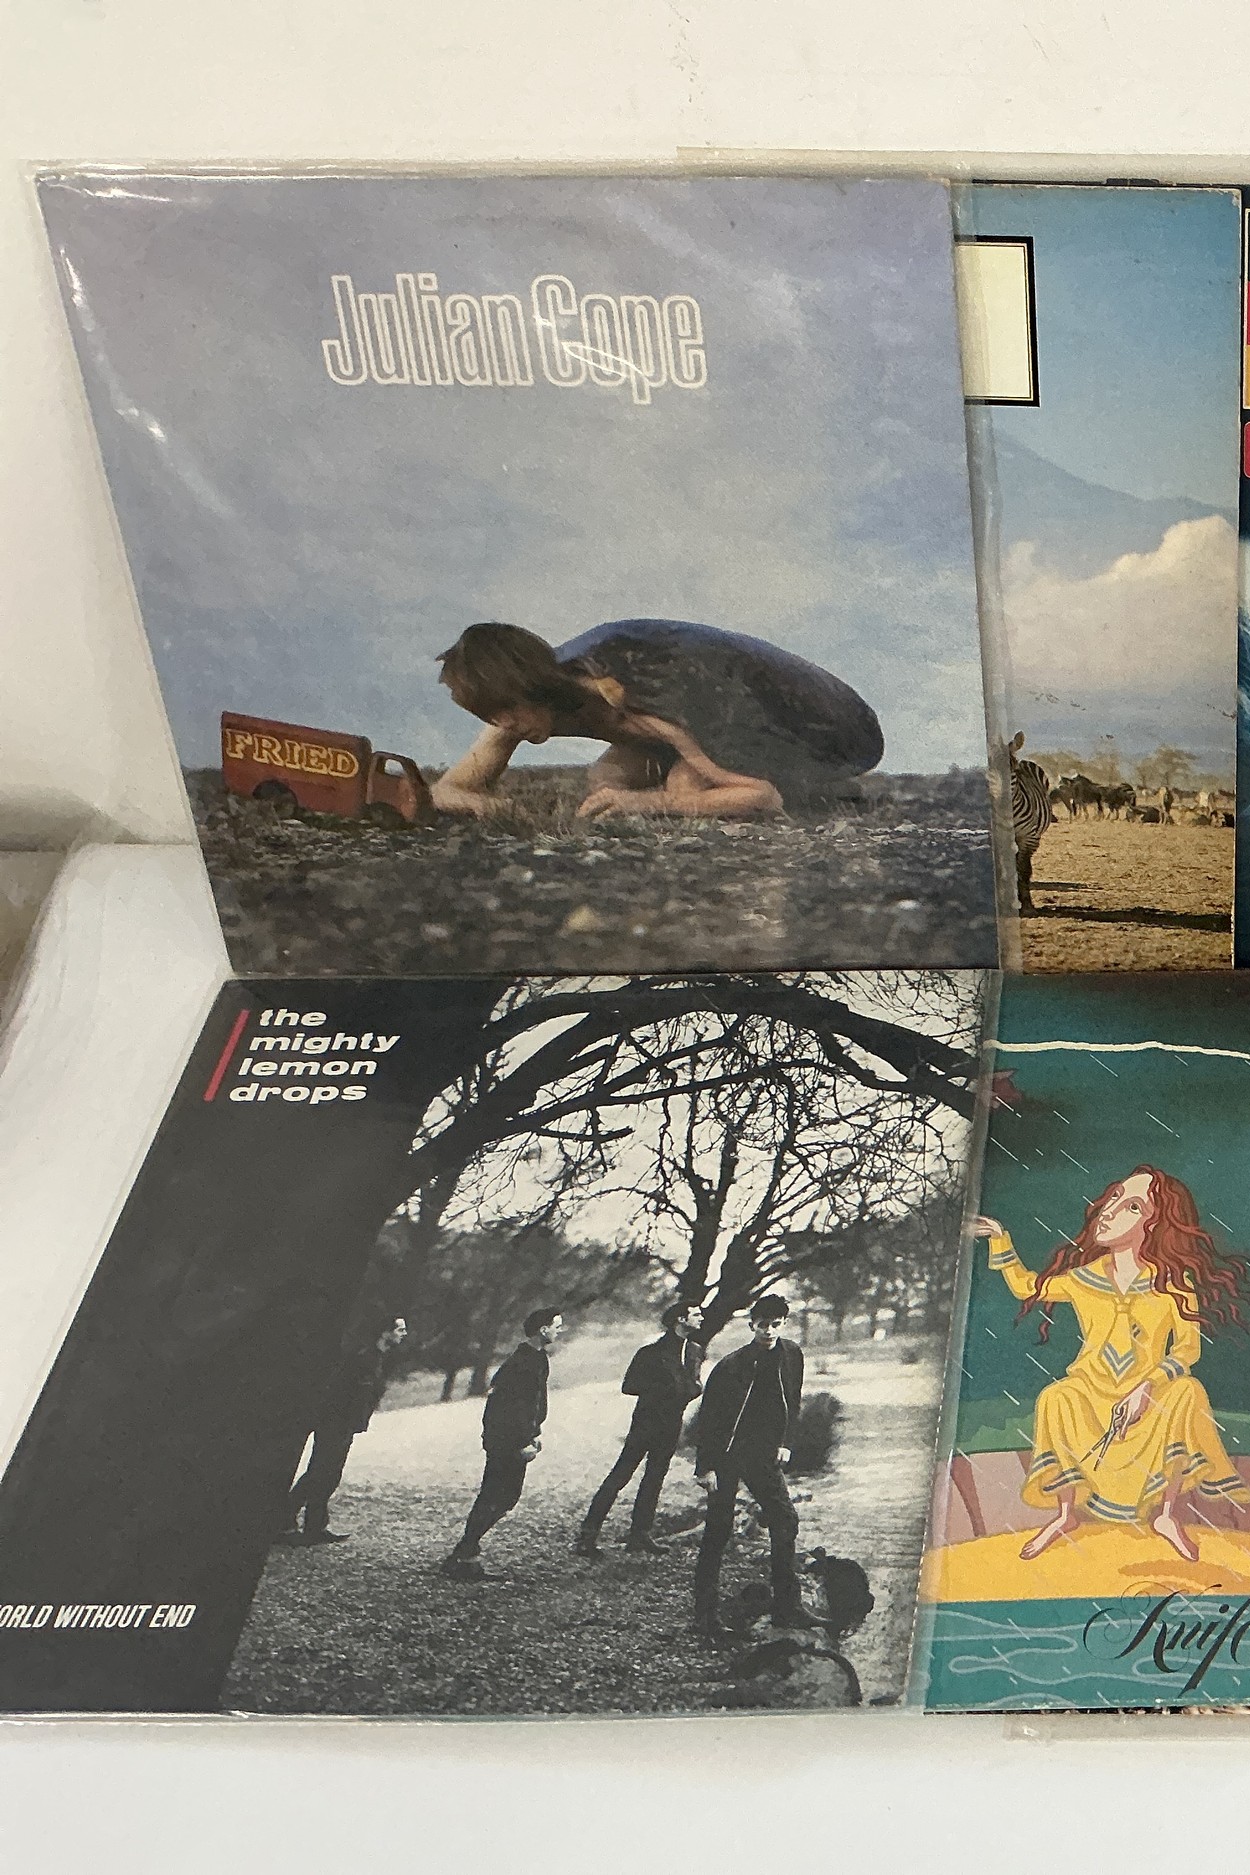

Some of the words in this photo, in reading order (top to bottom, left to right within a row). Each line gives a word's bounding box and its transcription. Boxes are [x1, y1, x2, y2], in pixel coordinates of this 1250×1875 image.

[321, 272, 534, 386] Julian
[531, 274, 707, 405] Cope
[225, 728, 359, 778] FRIED
[259, 1008, 327, 1027] the
[249, 1032, 401, 1055] mighty
[238, 1057, 378, 1076] lemon
[229, 1082, 368, 1105] drops
[0, 1604, 54, 1628] ORLD
[53, 1604, 152, 1629] WITHOUT
[148, 1604, 197, 1628] END
